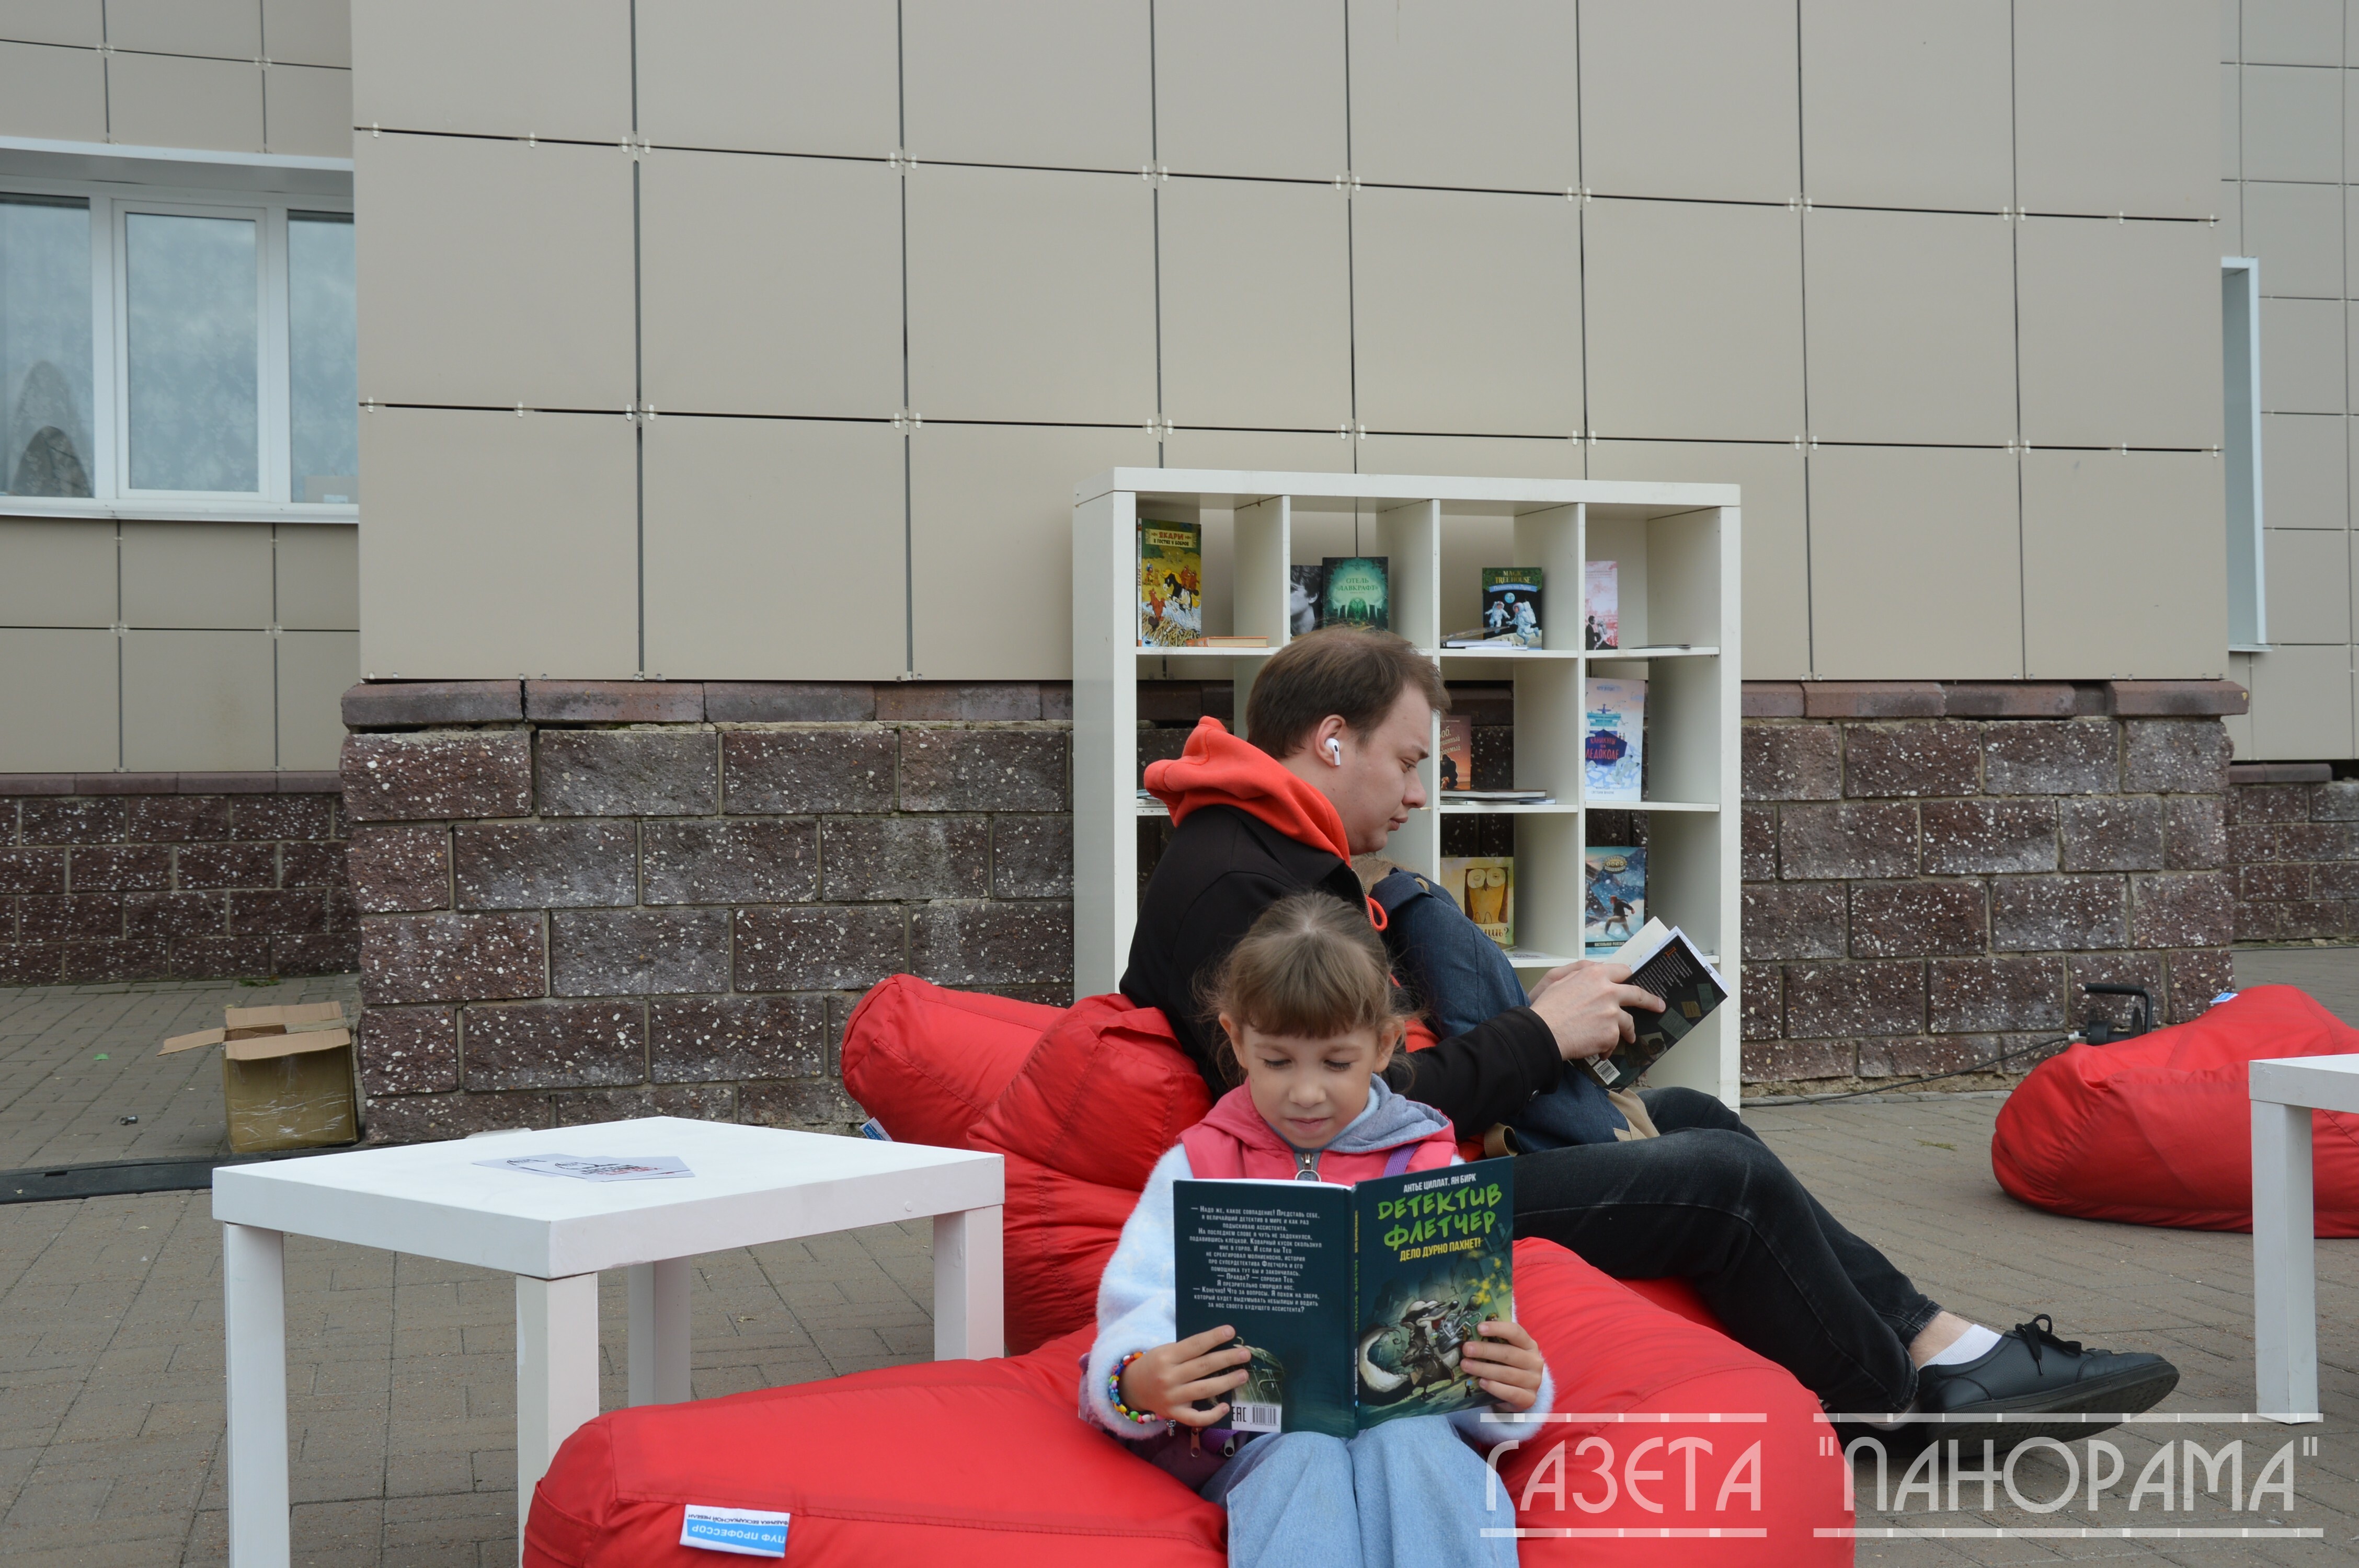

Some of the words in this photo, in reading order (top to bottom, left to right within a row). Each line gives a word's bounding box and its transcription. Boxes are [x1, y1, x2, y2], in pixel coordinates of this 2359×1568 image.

[1586, 748, 1619, 760] ЛЕДОКОЛЕ
[1403, 1182, 1423, 1193] АНТЬЕ
[1451, 1175, 1459, 1185] ЯН
[1460, 1173, 1476, 1183] БИРК
[1378, 1183, 1502, 1220] ДЕТЕКТИВ
[1384, 1209, 1496, 1251] ФЛЕТЧЕР
[1400, 1248, 1421, 1262] ДЕЛО
[1422, 1243, 1448, 1258] ДУРНО
[1449, 1237, 1481, 1252] ПАХНЕТ!
[712, 1516, 759, 1525] БЕСКАРКАСНОЙ
[692, 1525, 759, 1540] ПРОФЕССОР
[761, 1533, 785, 1544] ПУФ
